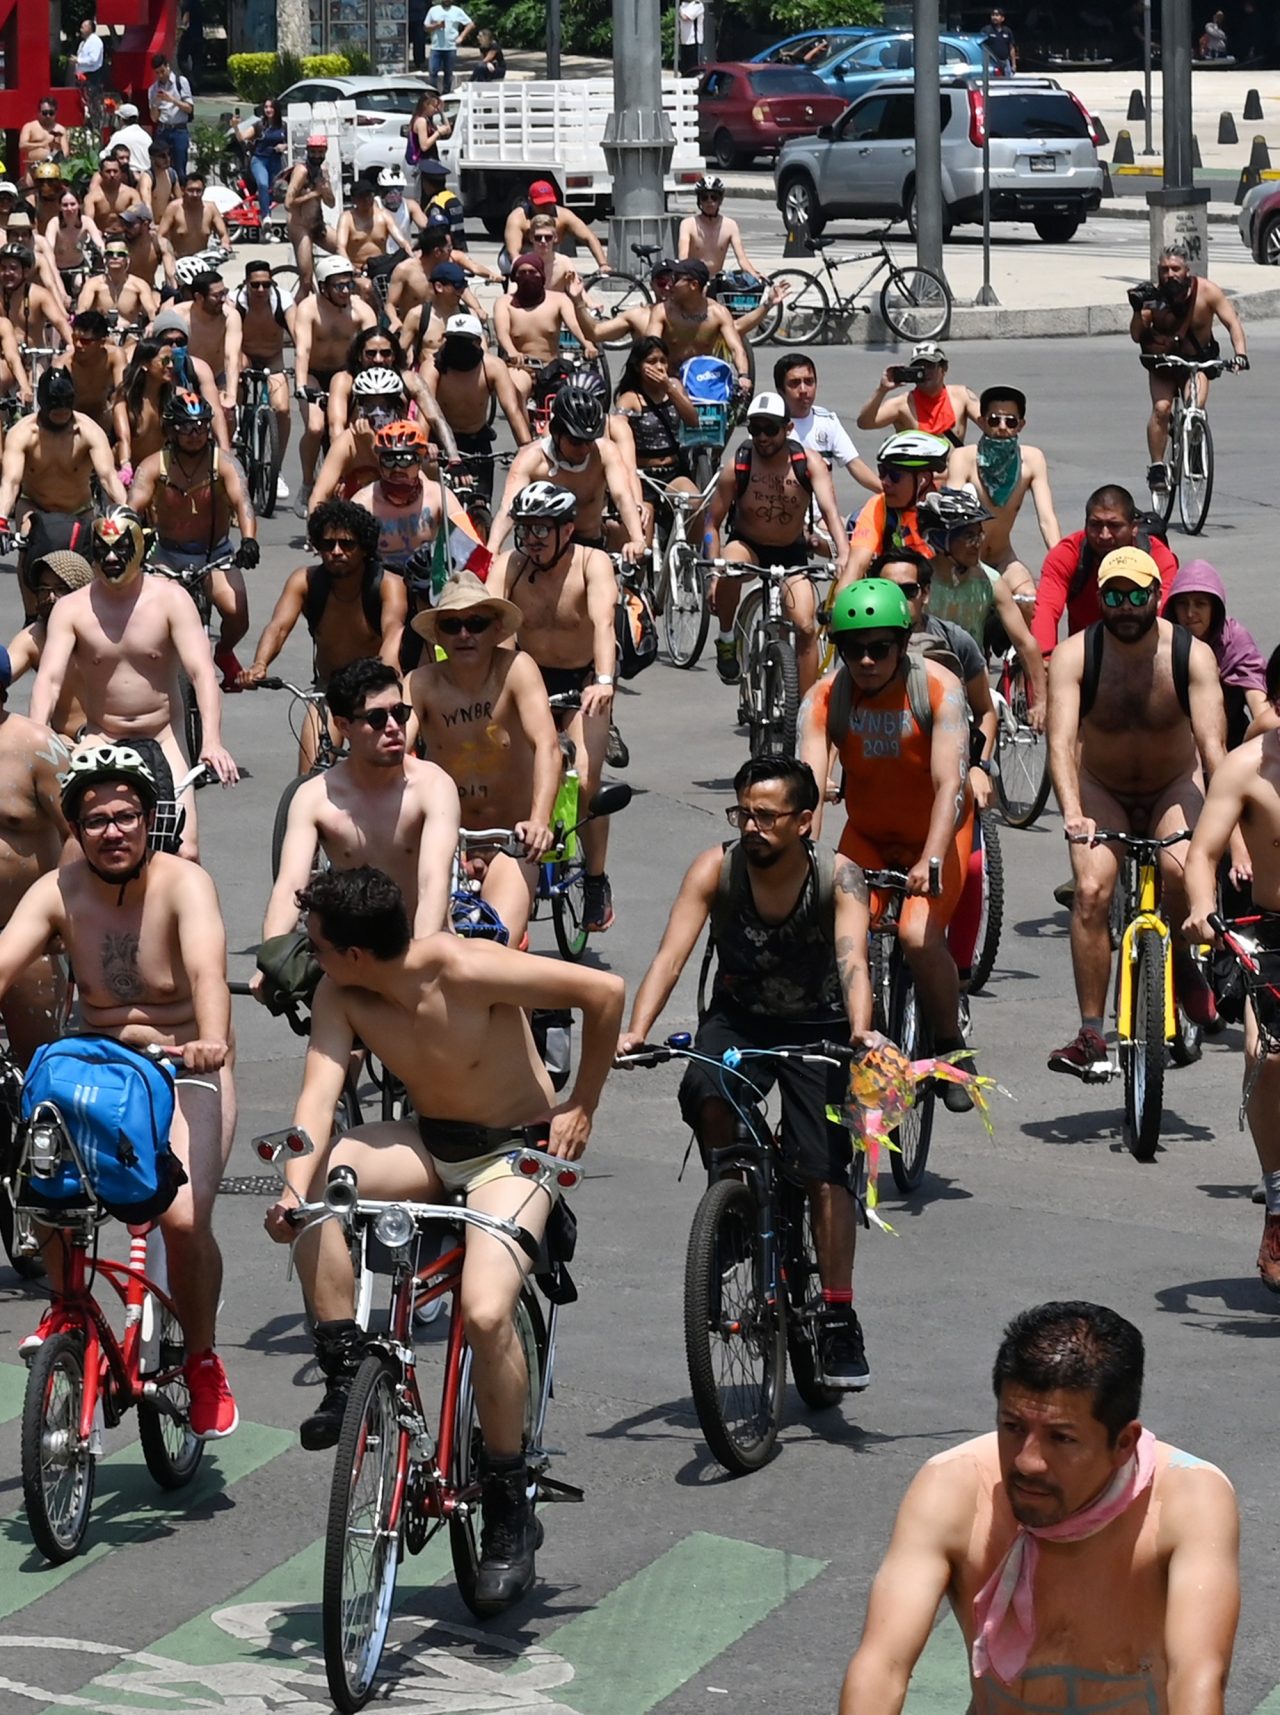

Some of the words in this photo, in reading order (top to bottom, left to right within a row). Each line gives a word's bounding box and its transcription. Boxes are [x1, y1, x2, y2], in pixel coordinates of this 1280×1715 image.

[442, 701, 493, 728] WNBR
[848, 706, 914, 737] WNBR
[863, 740, 900, 758] 2019
[458, 784, 488, 798] 019
